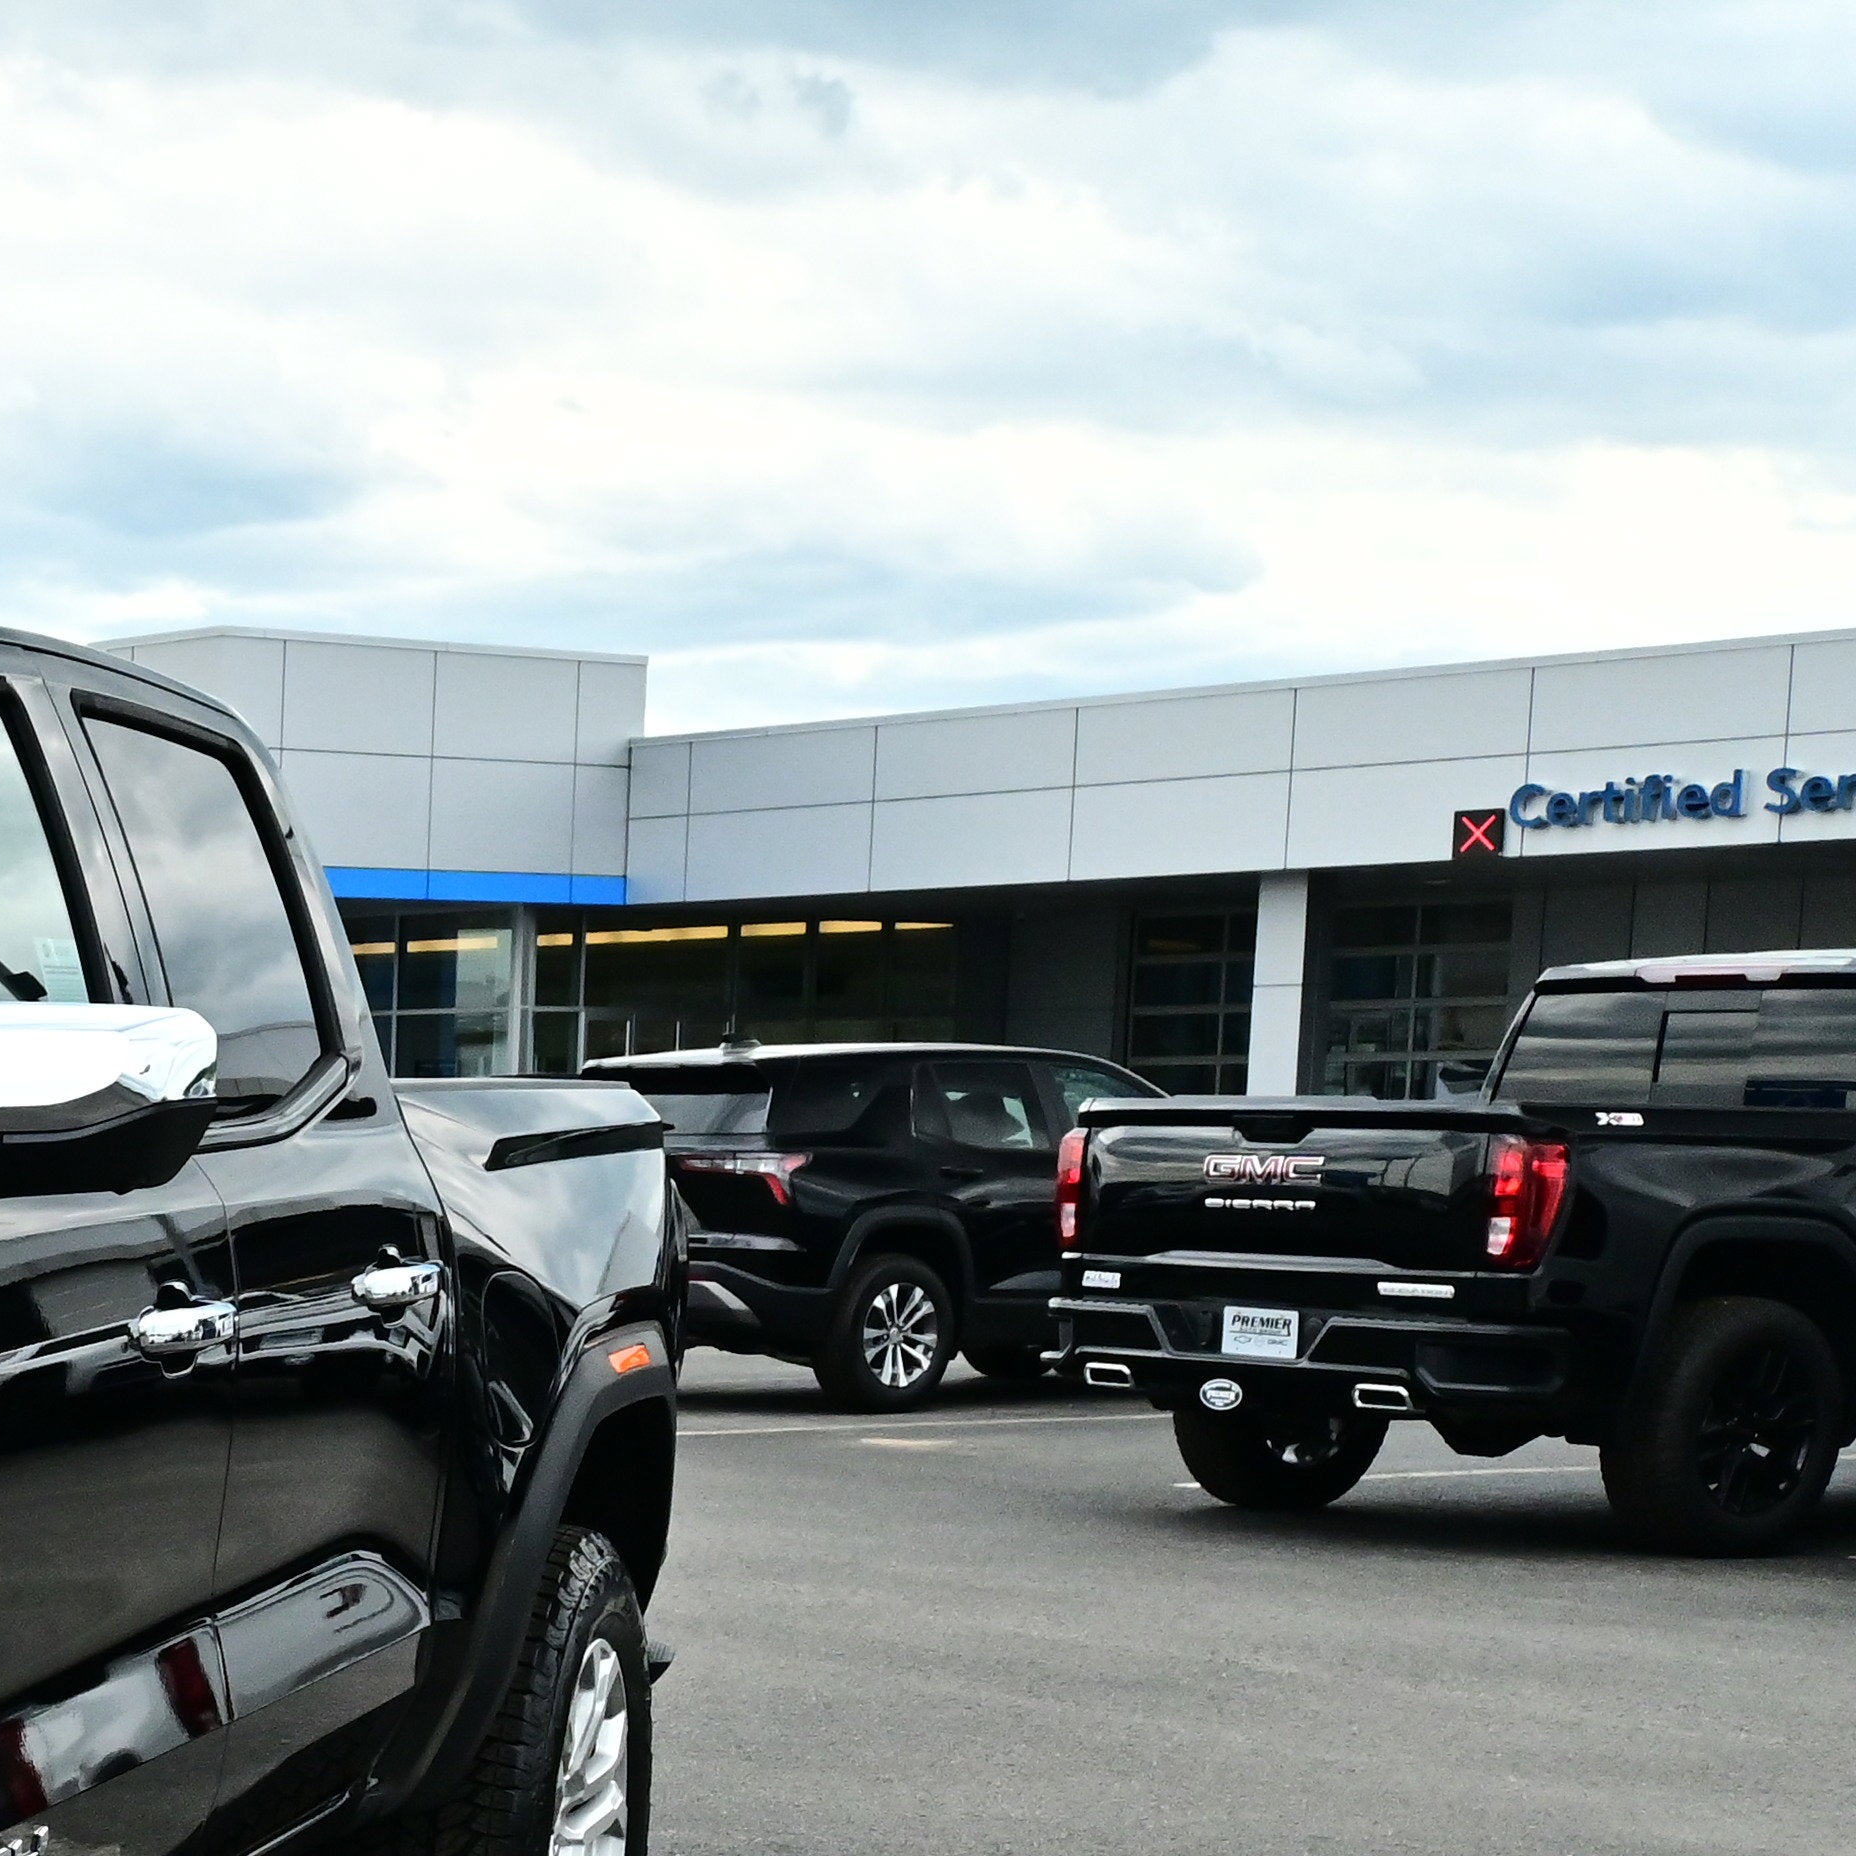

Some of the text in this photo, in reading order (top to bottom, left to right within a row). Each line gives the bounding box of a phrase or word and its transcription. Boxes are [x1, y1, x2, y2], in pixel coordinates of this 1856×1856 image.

[1510, 768, 1745, 829] Certified
[1203, 1154, 1325, 1187] GMC
[1204, 1197, 1317, 1211] SIERRA
[1231, 1314, 1293, 1334] PREMIER
